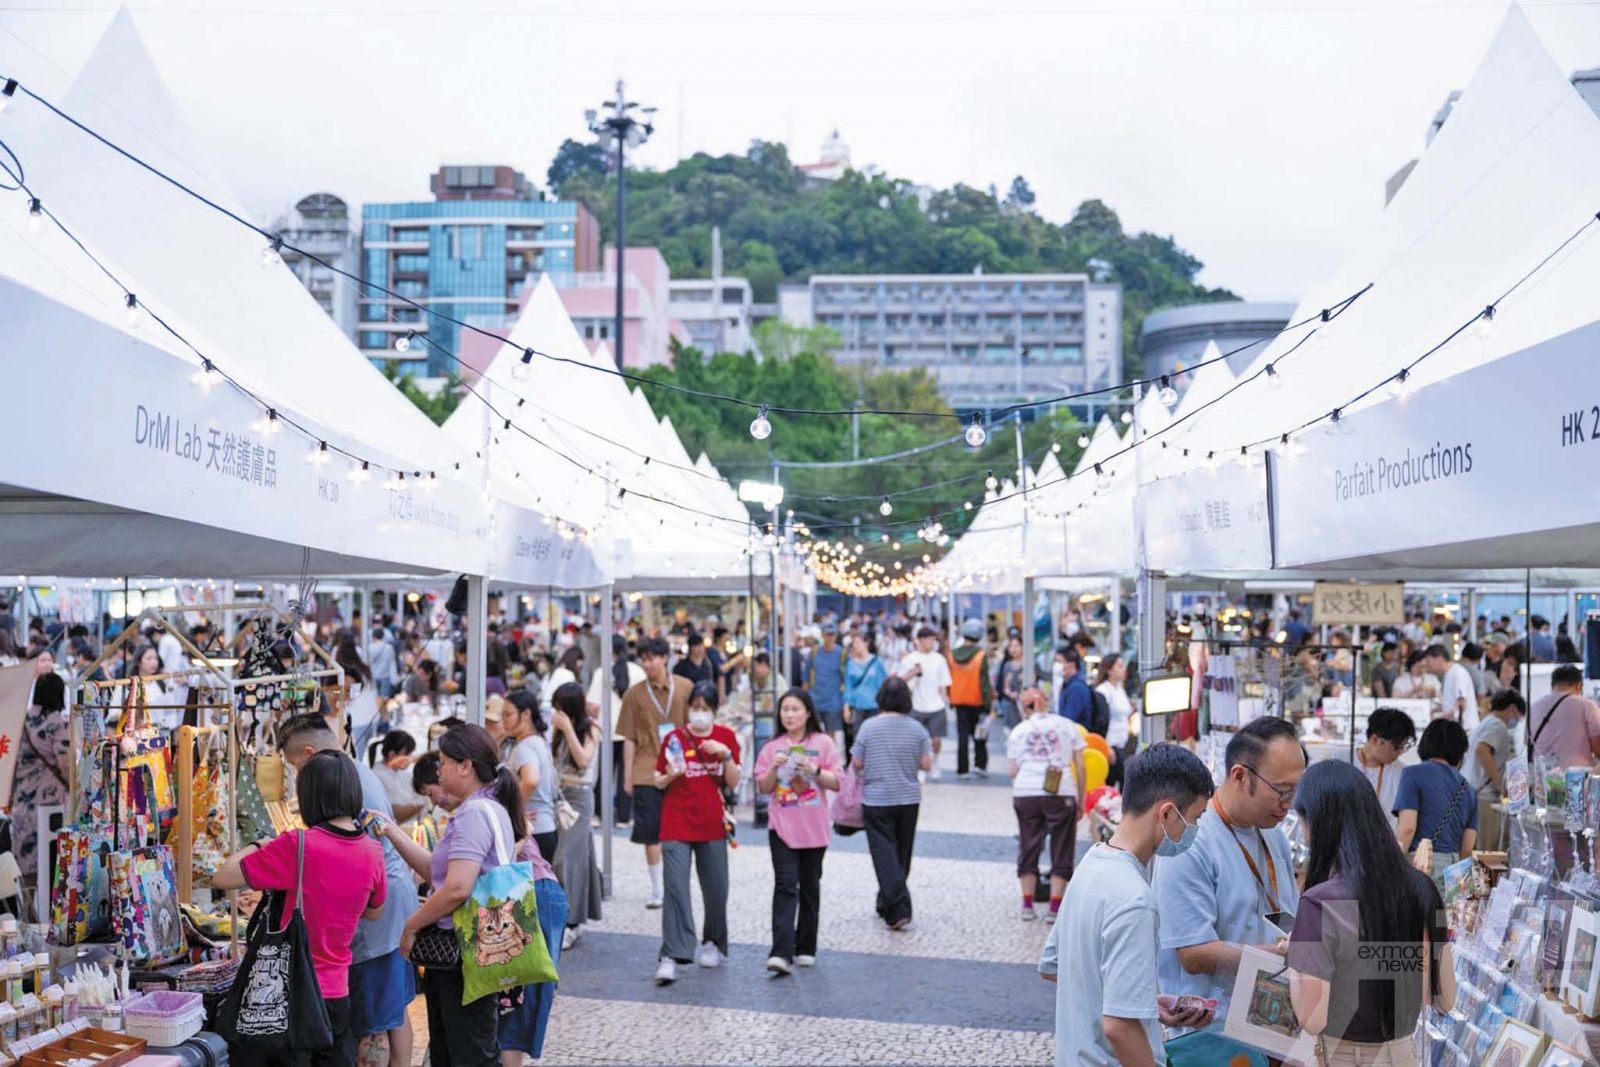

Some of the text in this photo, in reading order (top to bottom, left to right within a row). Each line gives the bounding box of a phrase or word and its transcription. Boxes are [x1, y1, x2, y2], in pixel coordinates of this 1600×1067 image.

[135, 405, 277, 489] DrM Lab 天然護膚品
[1562, 409, 1585, 447] HK
[318, 477, 329, 501] HK
[1335, 440, 1473, 502] Parfait Productions
